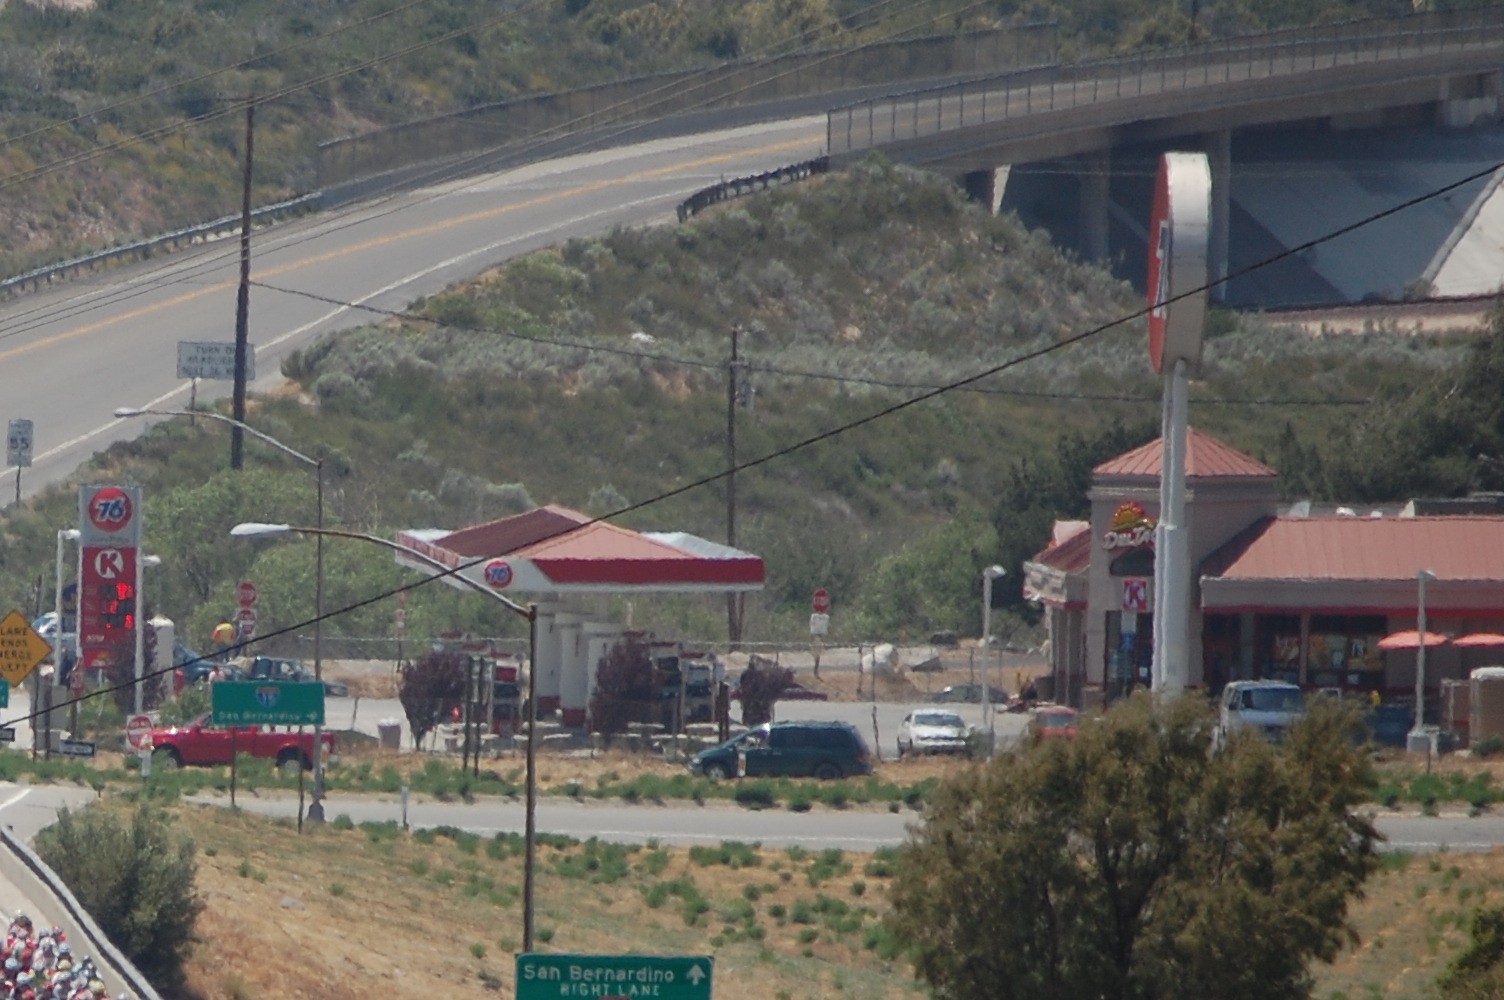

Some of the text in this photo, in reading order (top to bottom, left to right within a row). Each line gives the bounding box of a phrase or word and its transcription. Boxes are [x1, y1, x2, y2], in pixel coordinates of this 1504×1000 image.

[97, 500, 126, 521] 76
[99, 552, 122, 578] K
[0, 627, 28, 636] LANE
[523, 964, 675, 983] San Bernardino
[560, 983, 661, 997] RIGHT LANE
